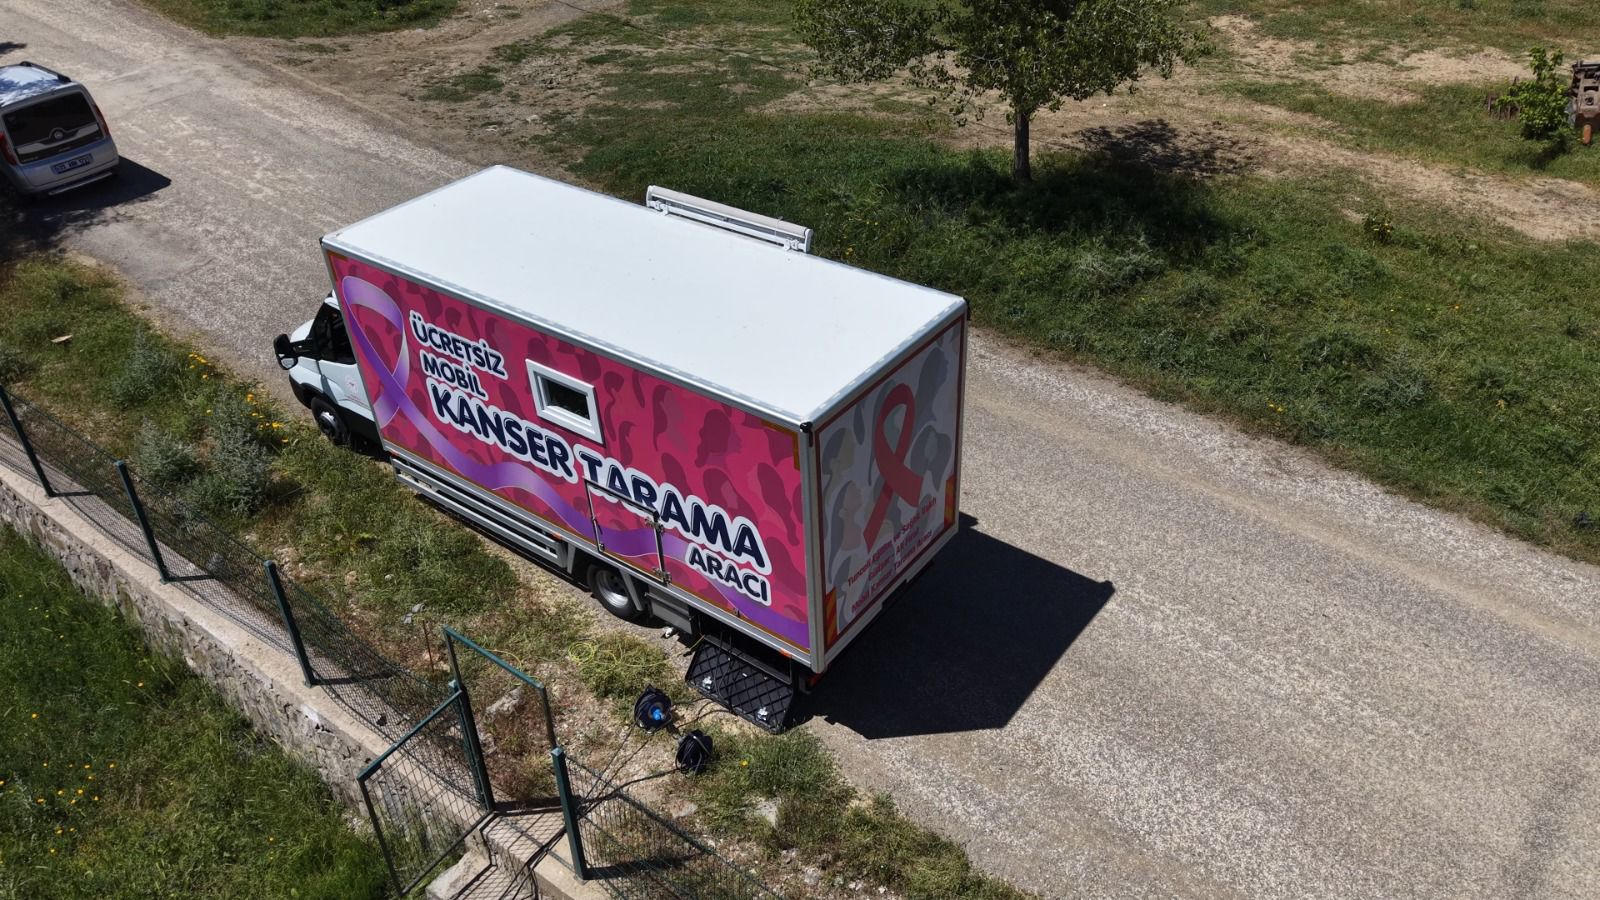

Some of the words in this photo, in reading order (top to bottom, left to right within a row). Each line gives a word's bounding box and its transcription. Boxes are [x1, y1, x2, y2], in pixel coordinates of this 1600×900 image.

[410, 312, 507, 378] ÜCRETSİZ
[421, 351, 487, 399] MOBİL
[429, 379, 577, 482] KANSER
[576, 446, 770, 572] TARAMA
[687, 545, 770, 604] ARACI
